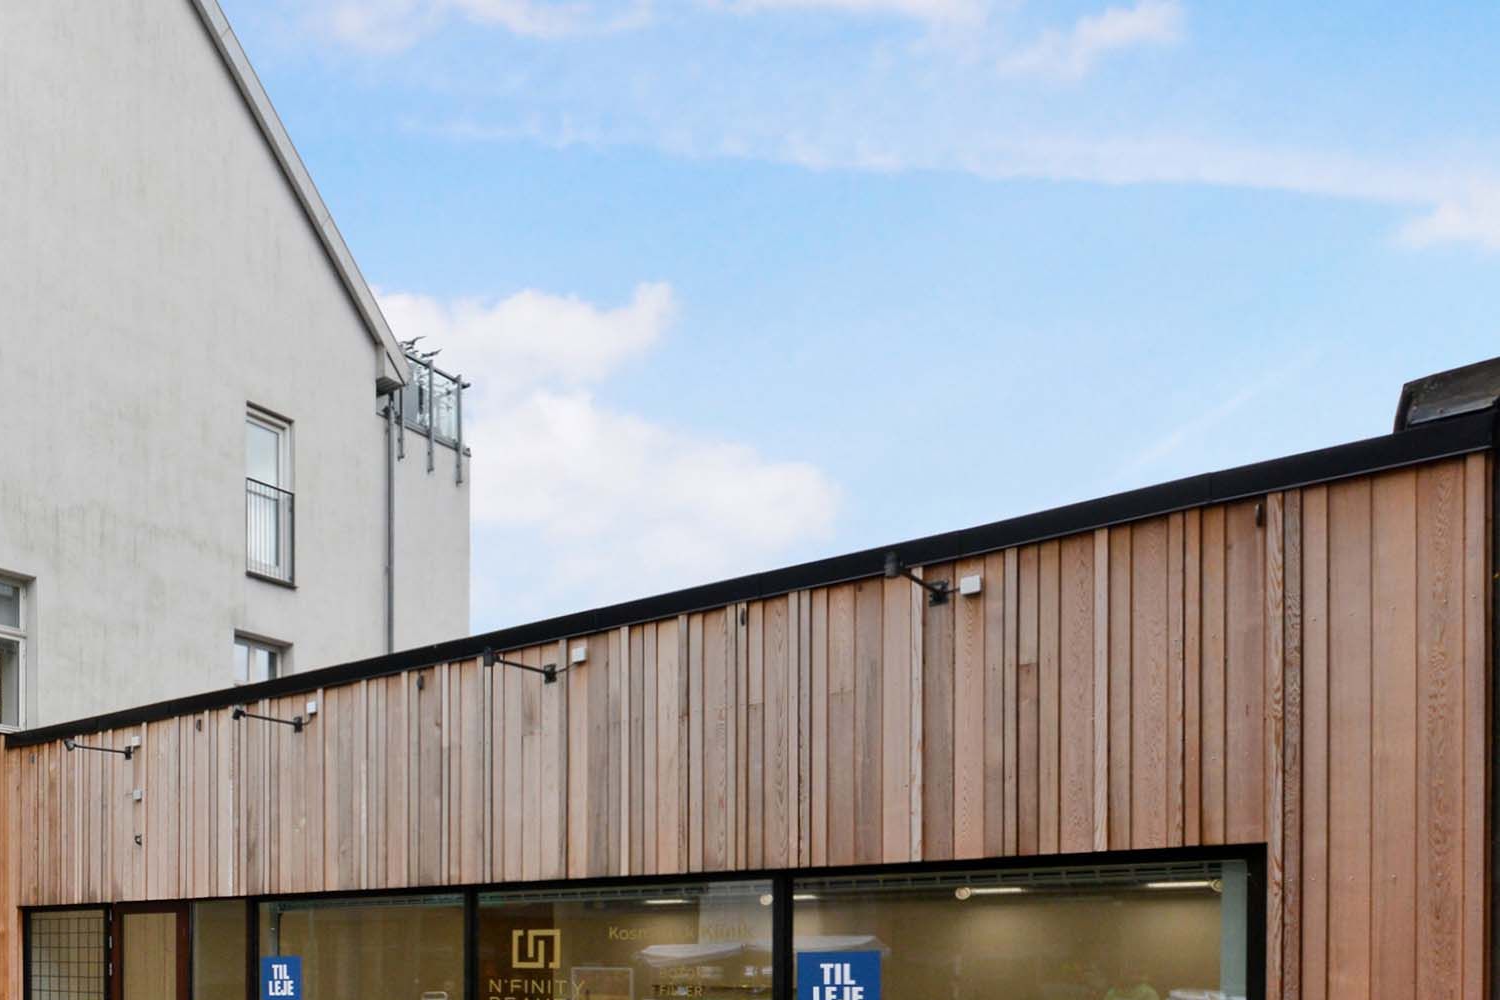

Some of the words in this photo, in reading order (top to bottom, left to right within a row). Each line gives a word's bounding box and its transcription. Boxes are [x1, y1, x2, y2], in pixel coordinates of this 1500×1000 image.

[271, 963, 291, 980] TIL
[819, 962, 857, 985] TIL
[268, 980, 295, 997] LEJE
